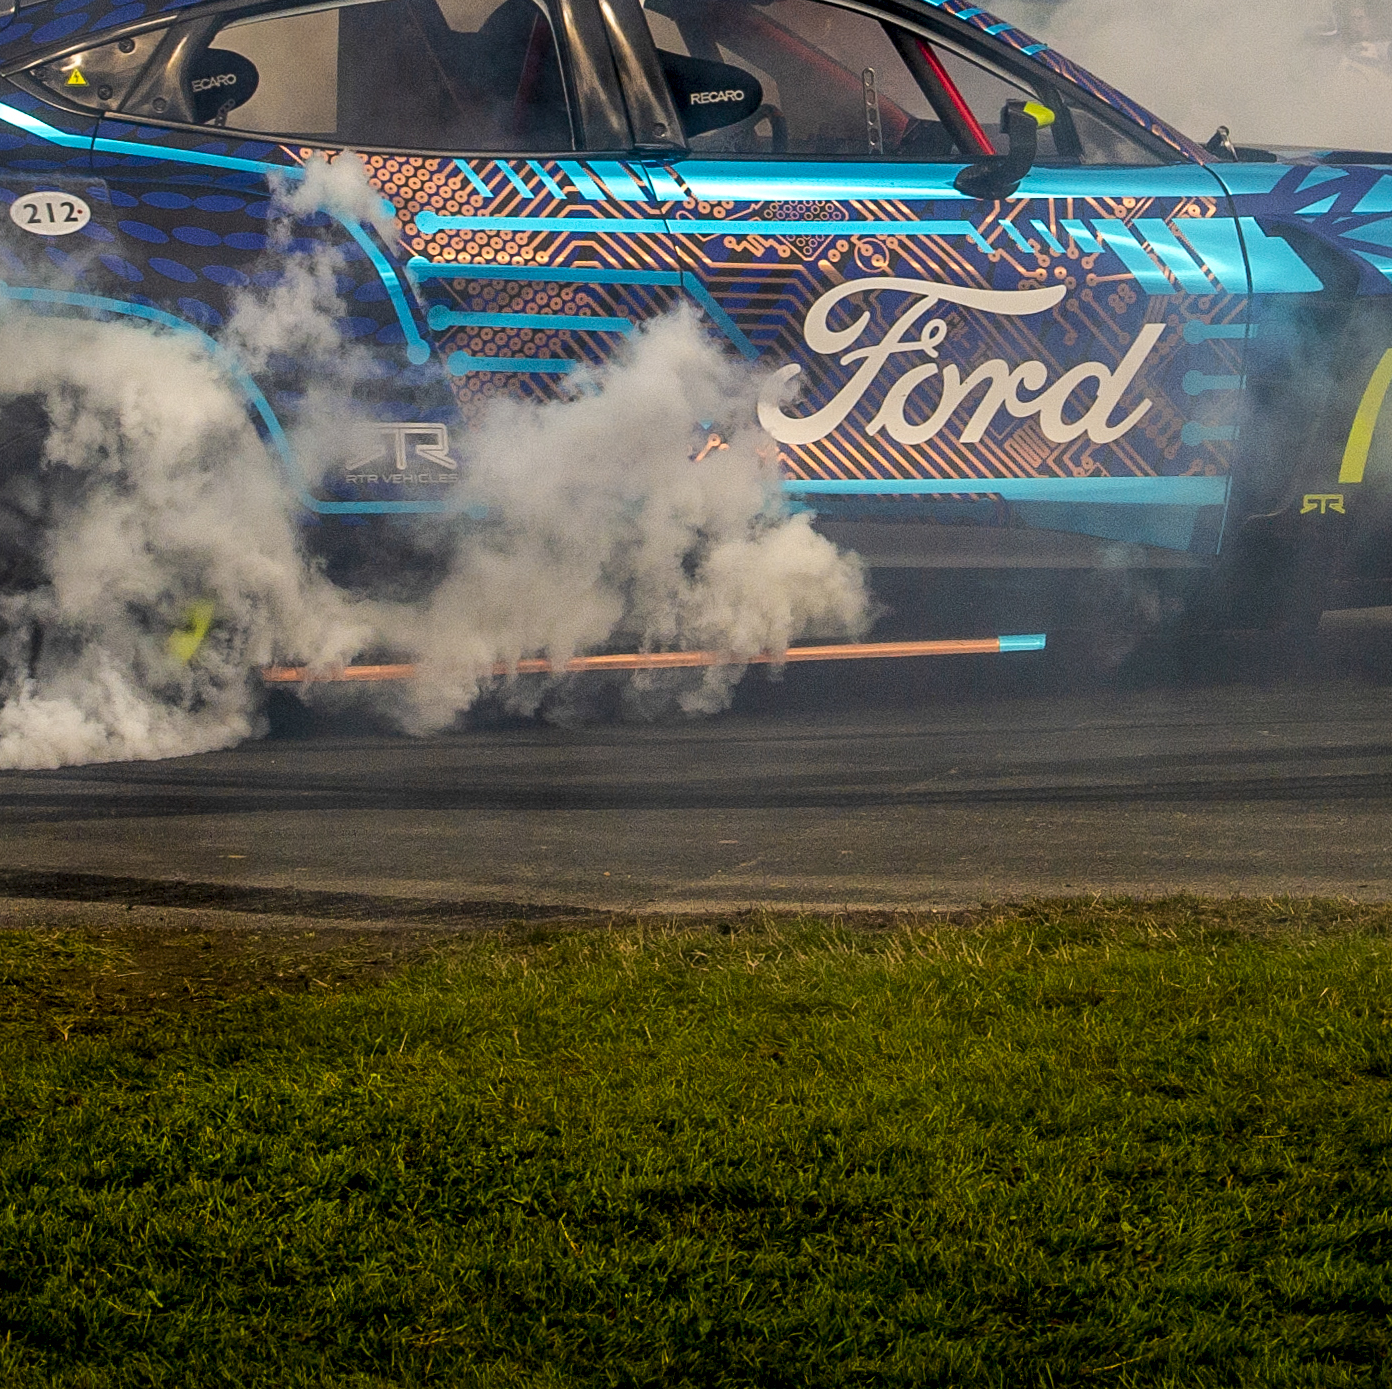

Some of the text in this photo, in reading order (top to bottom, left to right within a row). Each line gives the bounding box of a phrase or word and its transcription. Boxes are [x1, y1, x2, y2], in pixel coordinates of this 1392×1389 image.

[191, 73, 237, 92] ECARO
[690, 89, 745, 105] RECARO
[23, 201, 79, 224] 212
[757, 277, 1167, 445] Ford
[346, 473, 459, 484] RTR VEHICLES
